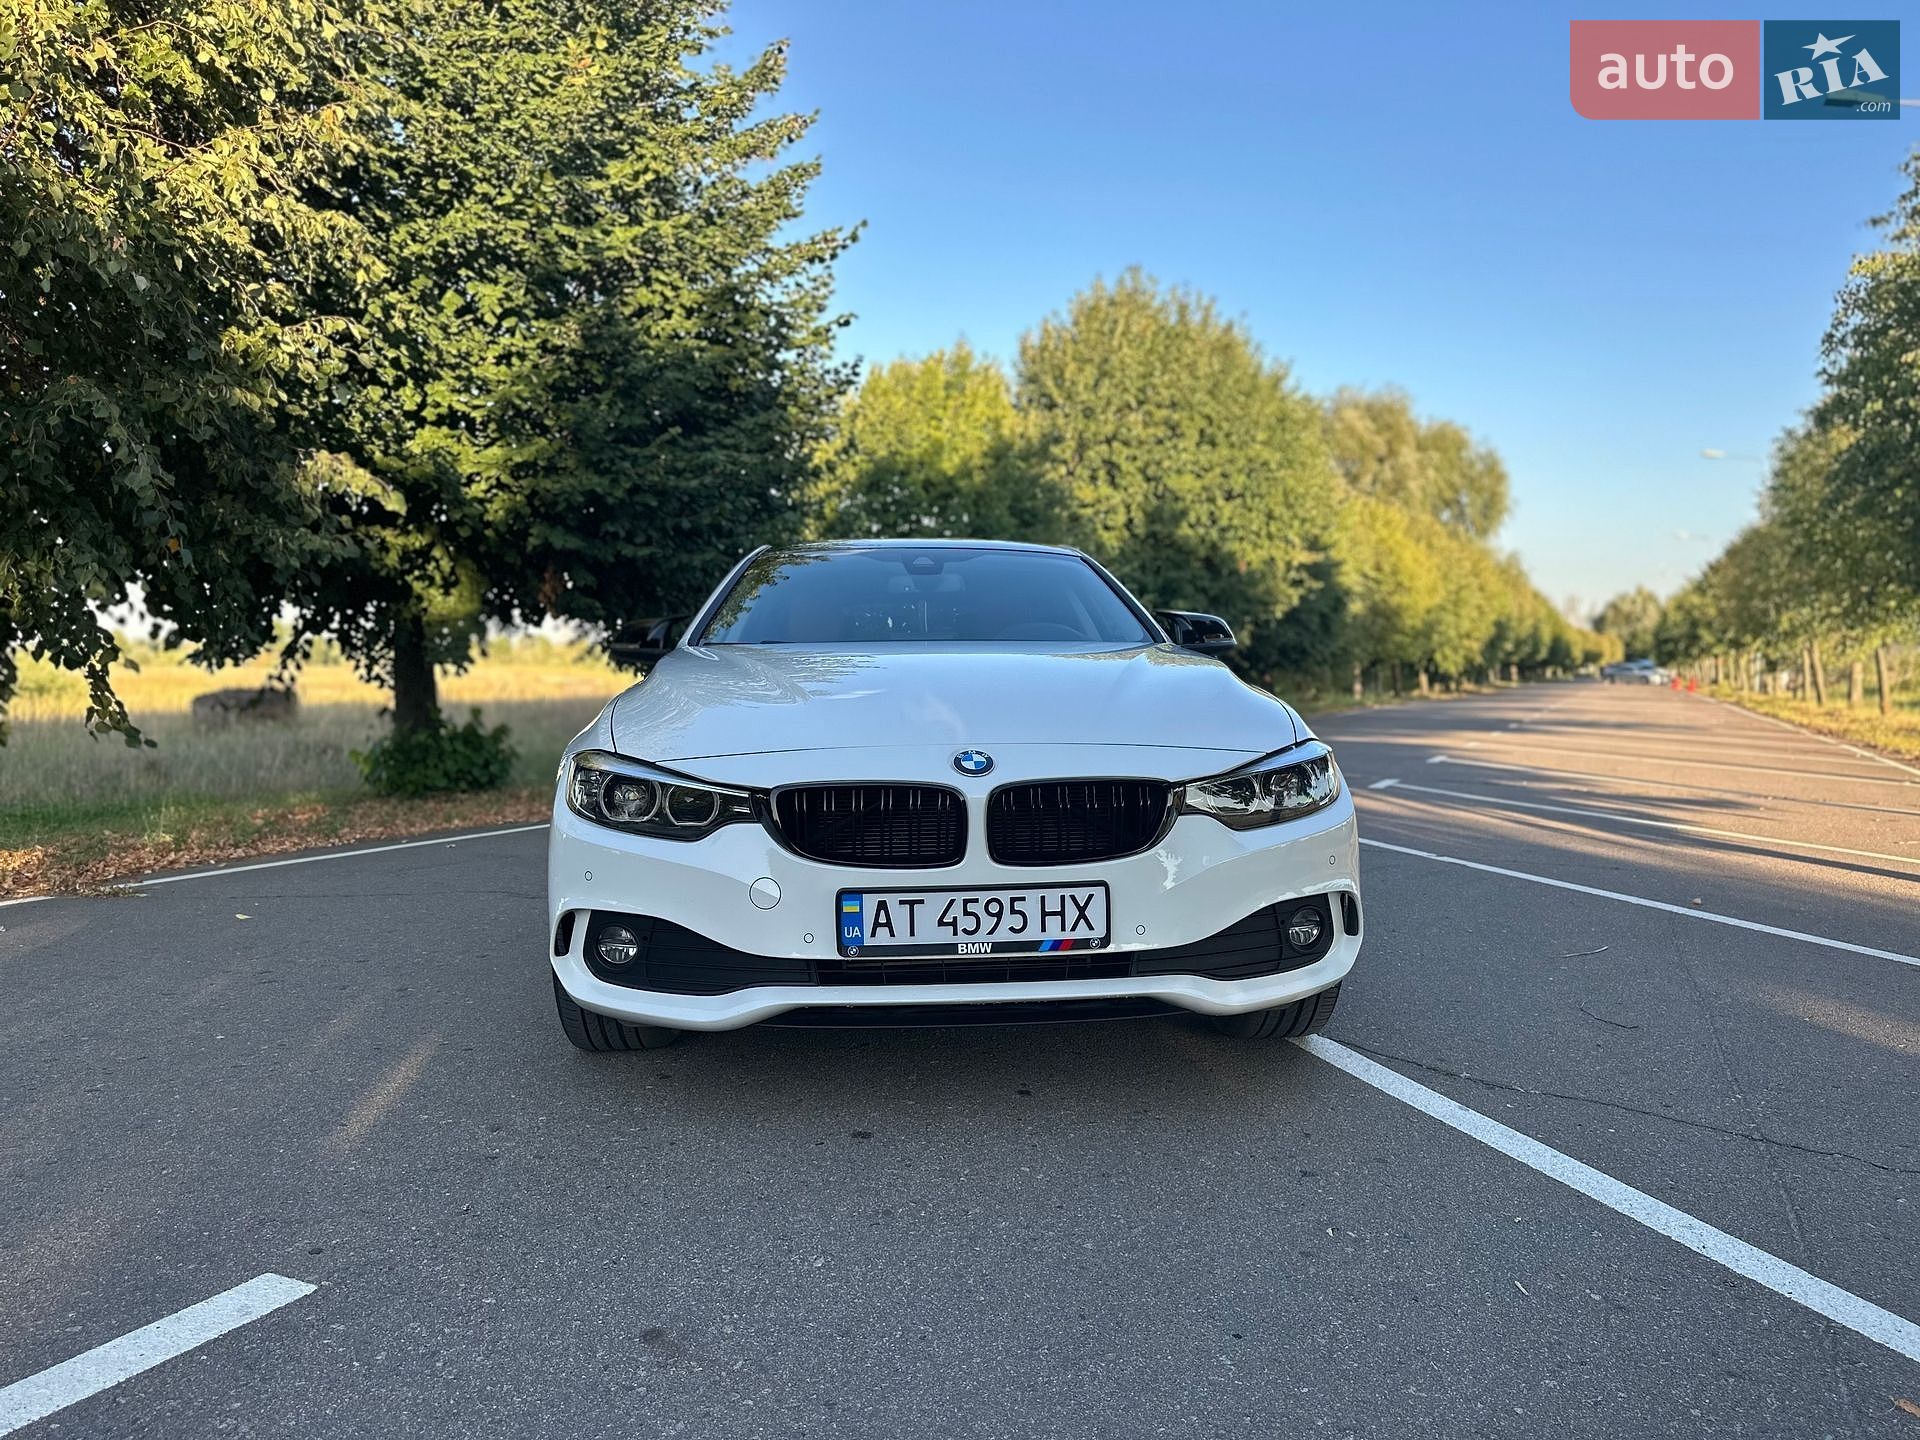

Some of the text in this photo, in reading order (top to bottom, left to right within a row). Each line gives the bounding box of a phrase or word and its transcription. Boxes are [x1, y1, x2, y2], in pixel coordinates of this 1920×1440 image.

[870, 893, 1095, 938] AT 4595 HX
[844, 926, 862, 938] UA
[957, 942, 992, 954] BMW
